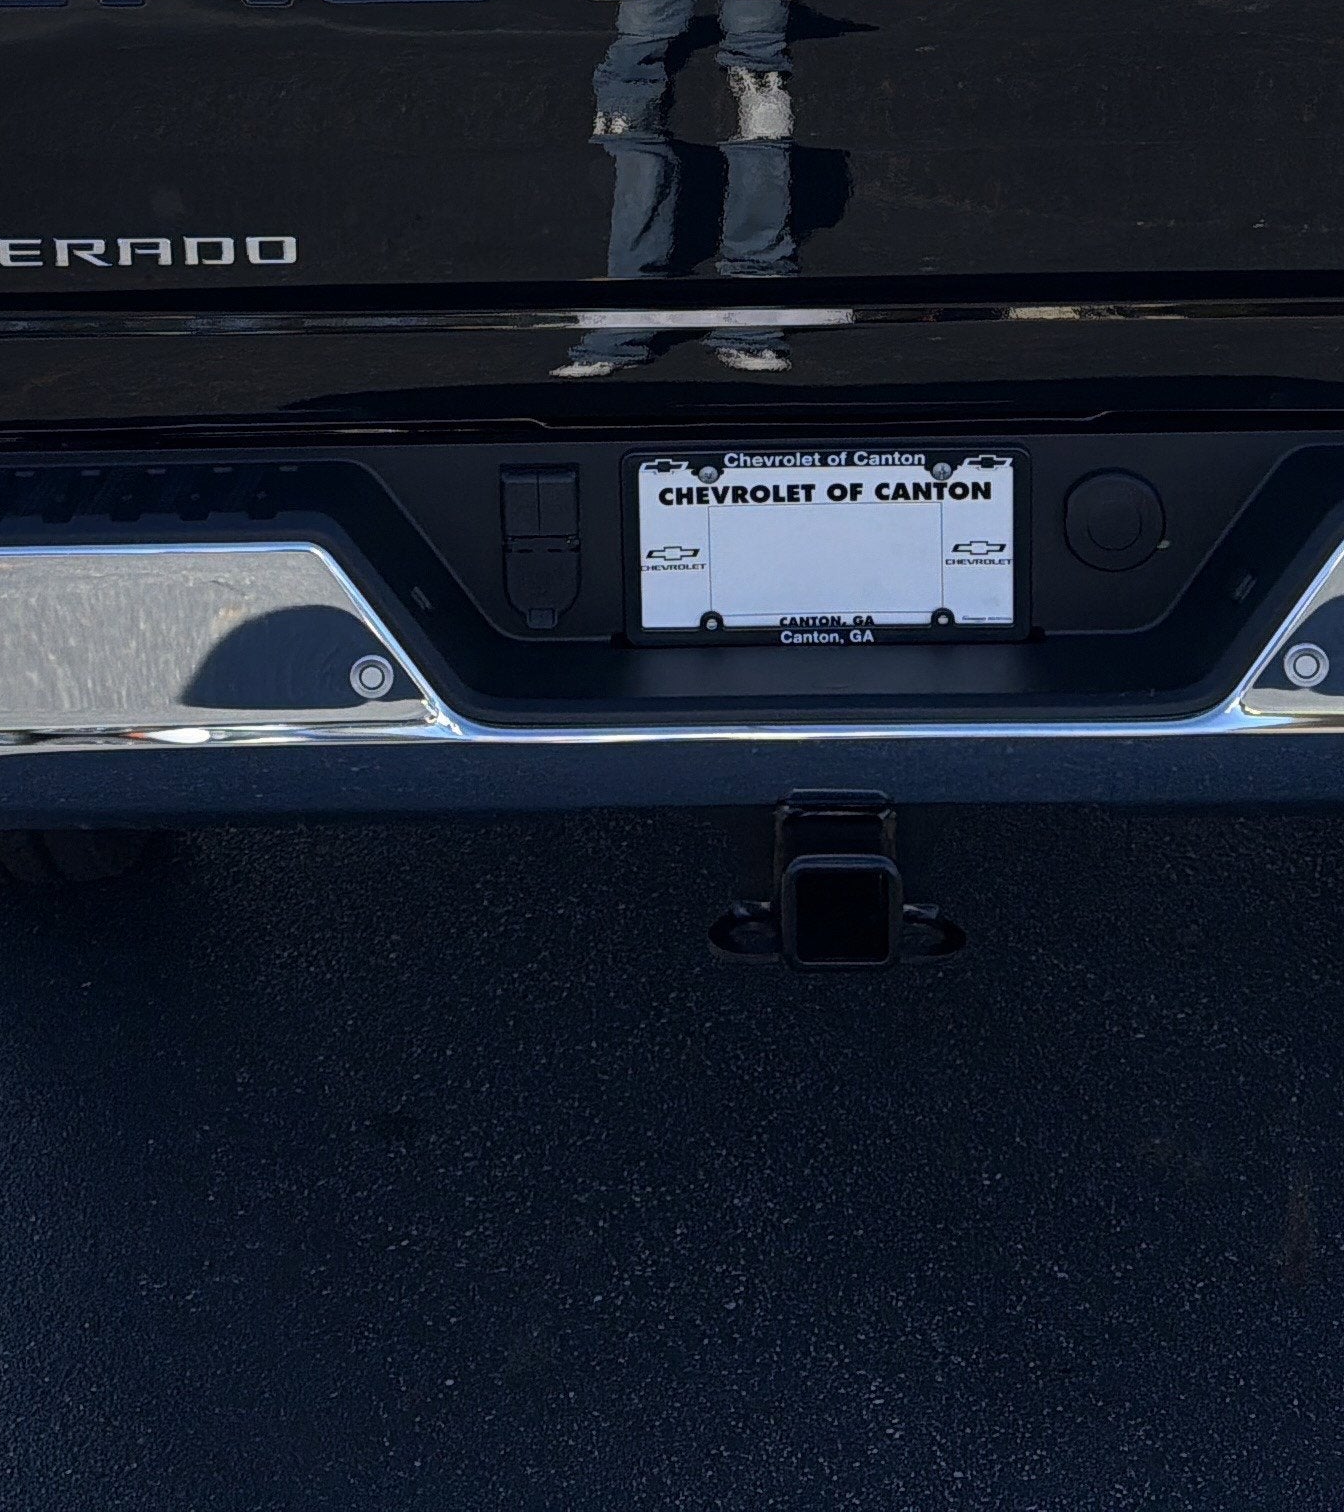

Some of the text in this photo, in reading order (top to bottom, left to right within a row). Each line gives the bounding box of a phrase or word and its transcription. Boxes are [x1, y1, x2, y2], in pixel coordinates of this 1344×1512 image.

[724, 451, 926, 467] Chevrolet of Canton
[658, 481, 992, 505] CHEVROLET OF CANTON
[641, 563, 707, 572] CHEVROLET
[945, 558, 1013, 566] CHEVROLET
[852, 615, 875, 626] GA
[780, 629, 875, 644] Canton, GA
